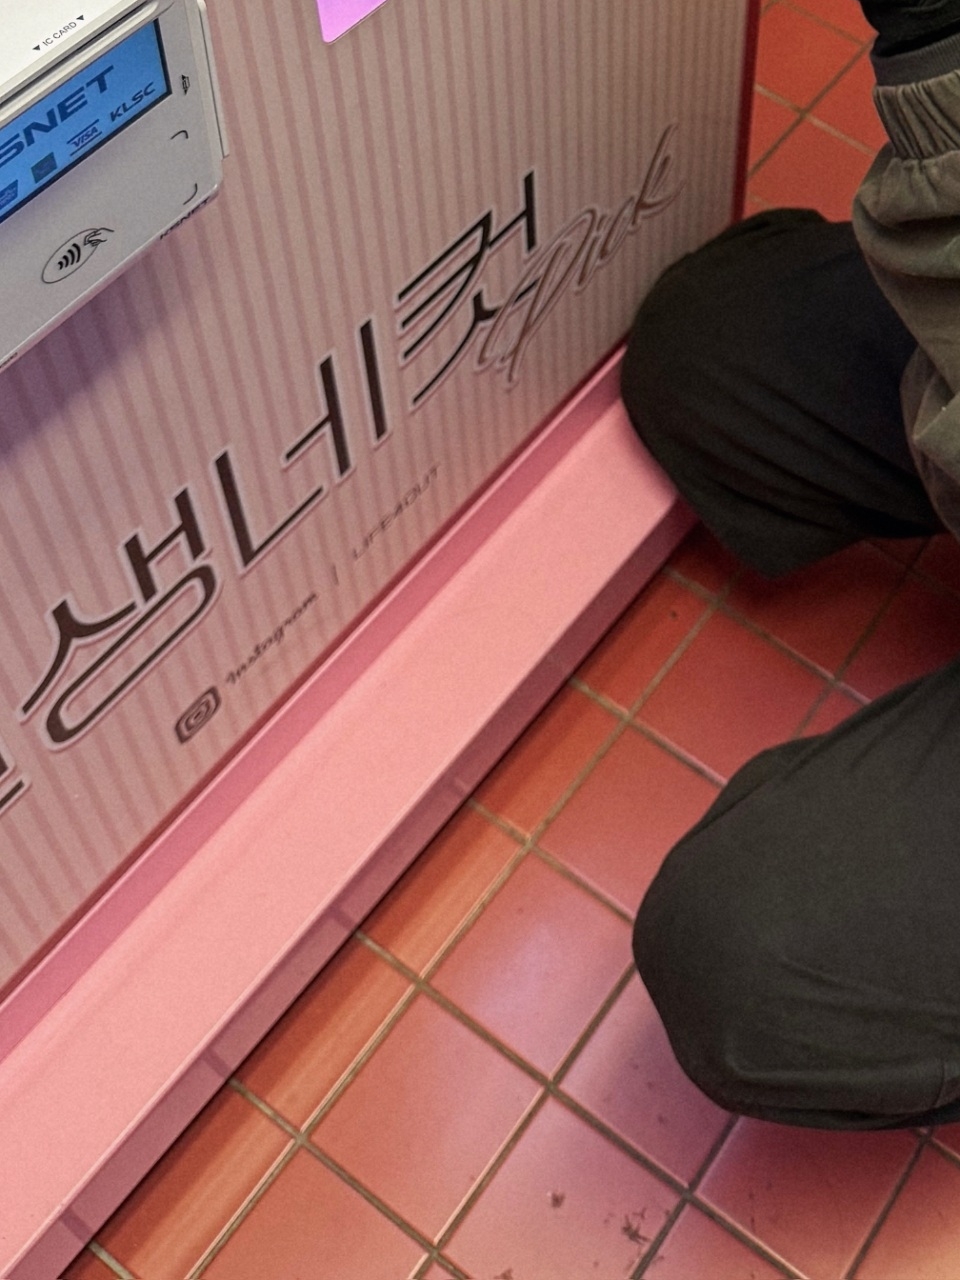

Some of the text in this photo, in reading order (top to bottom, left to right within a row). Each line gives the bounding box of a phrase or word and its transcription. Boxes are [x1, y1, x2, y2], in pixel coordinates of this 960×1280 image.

[42, 21, 78, 47] IC CARD
[109, 81, 156, 123] KLSC
[71, 126, 99, 148] VISA
